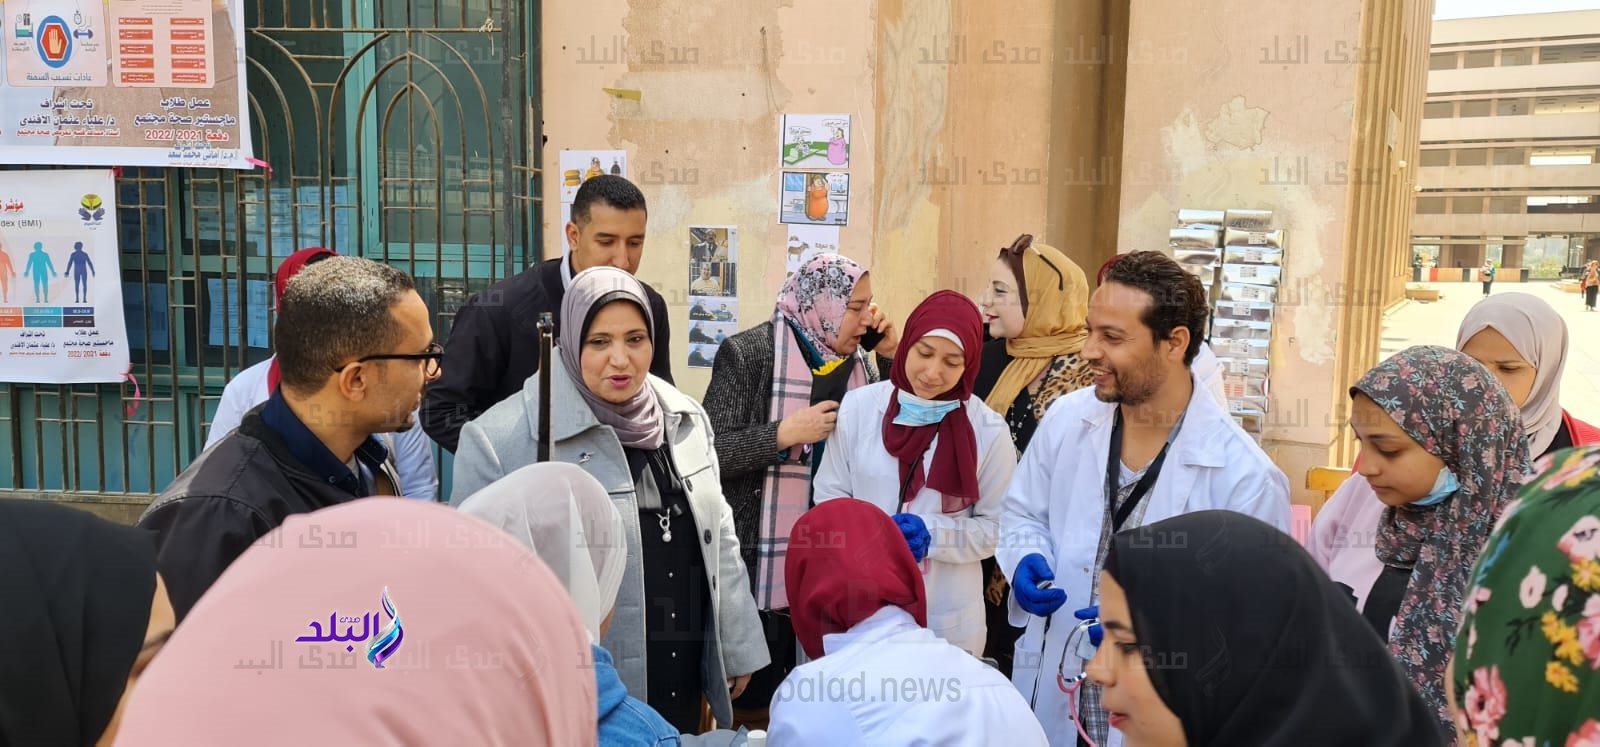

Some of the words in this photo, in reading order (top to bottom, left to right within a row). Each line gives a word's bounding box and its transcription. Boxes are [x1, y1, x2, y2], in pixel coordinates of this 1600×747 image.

[70, 98, 93, 109] تحت
[161, 97, 186, 109] طلاب
[189, 98, 210, 109] عمل
[53, 114, 80, 126] عثمان
[134, 113, 166, 126] مجتمع
[169, 112, 192, 124] صحة
[195, 114, 235, 126] ماجستير
[176, 130, 203, 140] 2021
[206, 129, 229, 140] دفعة
